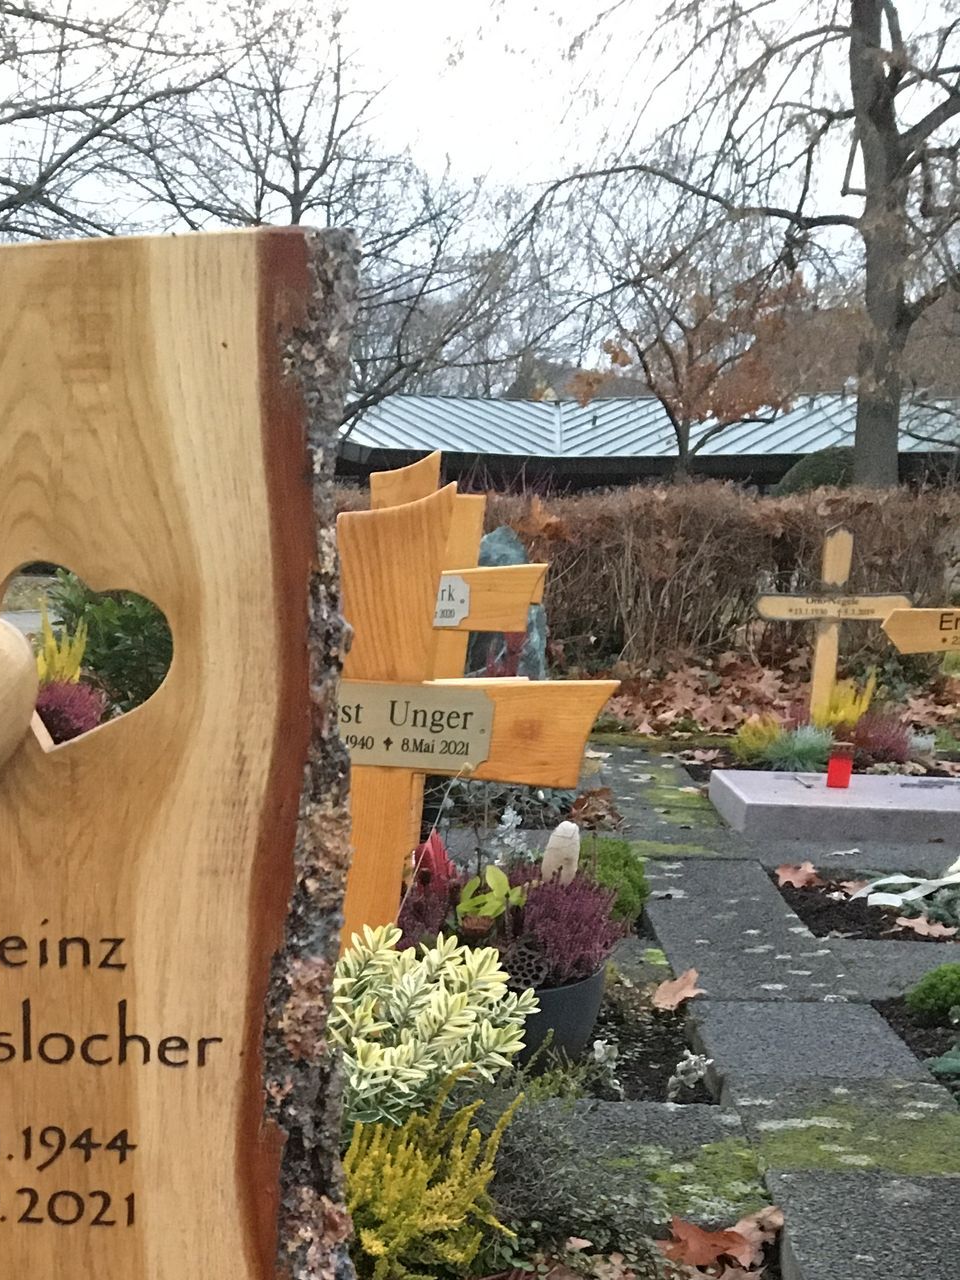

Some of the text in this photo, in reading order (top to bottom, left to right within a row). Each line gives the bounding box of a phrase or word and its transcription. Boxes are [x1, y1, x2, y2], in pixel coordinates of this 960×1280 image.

[338, 700, 475, 734] st Unger
[439, 740, 470, 756] 2021
